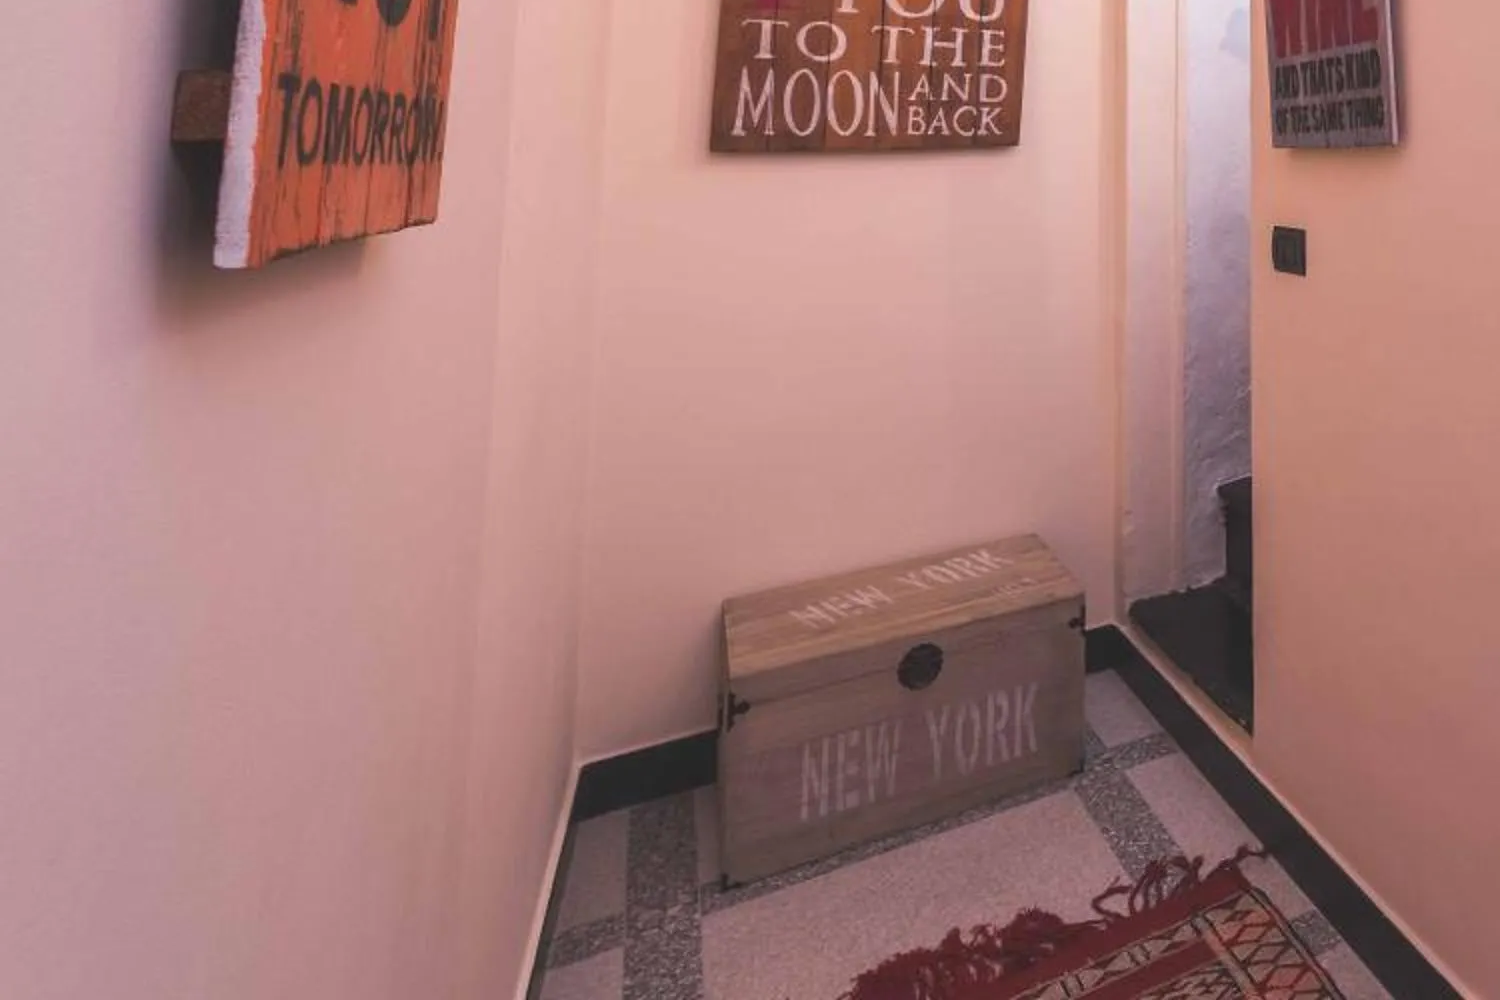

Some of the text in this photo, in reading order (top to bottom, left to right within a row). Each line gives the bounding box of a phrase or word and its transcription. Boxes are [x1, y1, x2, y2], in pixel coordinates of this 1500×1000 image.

[741, 19, 1005, 67] TO THE
[731, 65, 1008, 137] MOON AND
[1275, 64, 1299, 100] AND
[908, 105, 1003, 137] BACK
[1312, 101, 1345, 134] SAME
[789, 548, 1013, 630] NEW YORK
[801, 681, 1039, 821] NEW YORK
